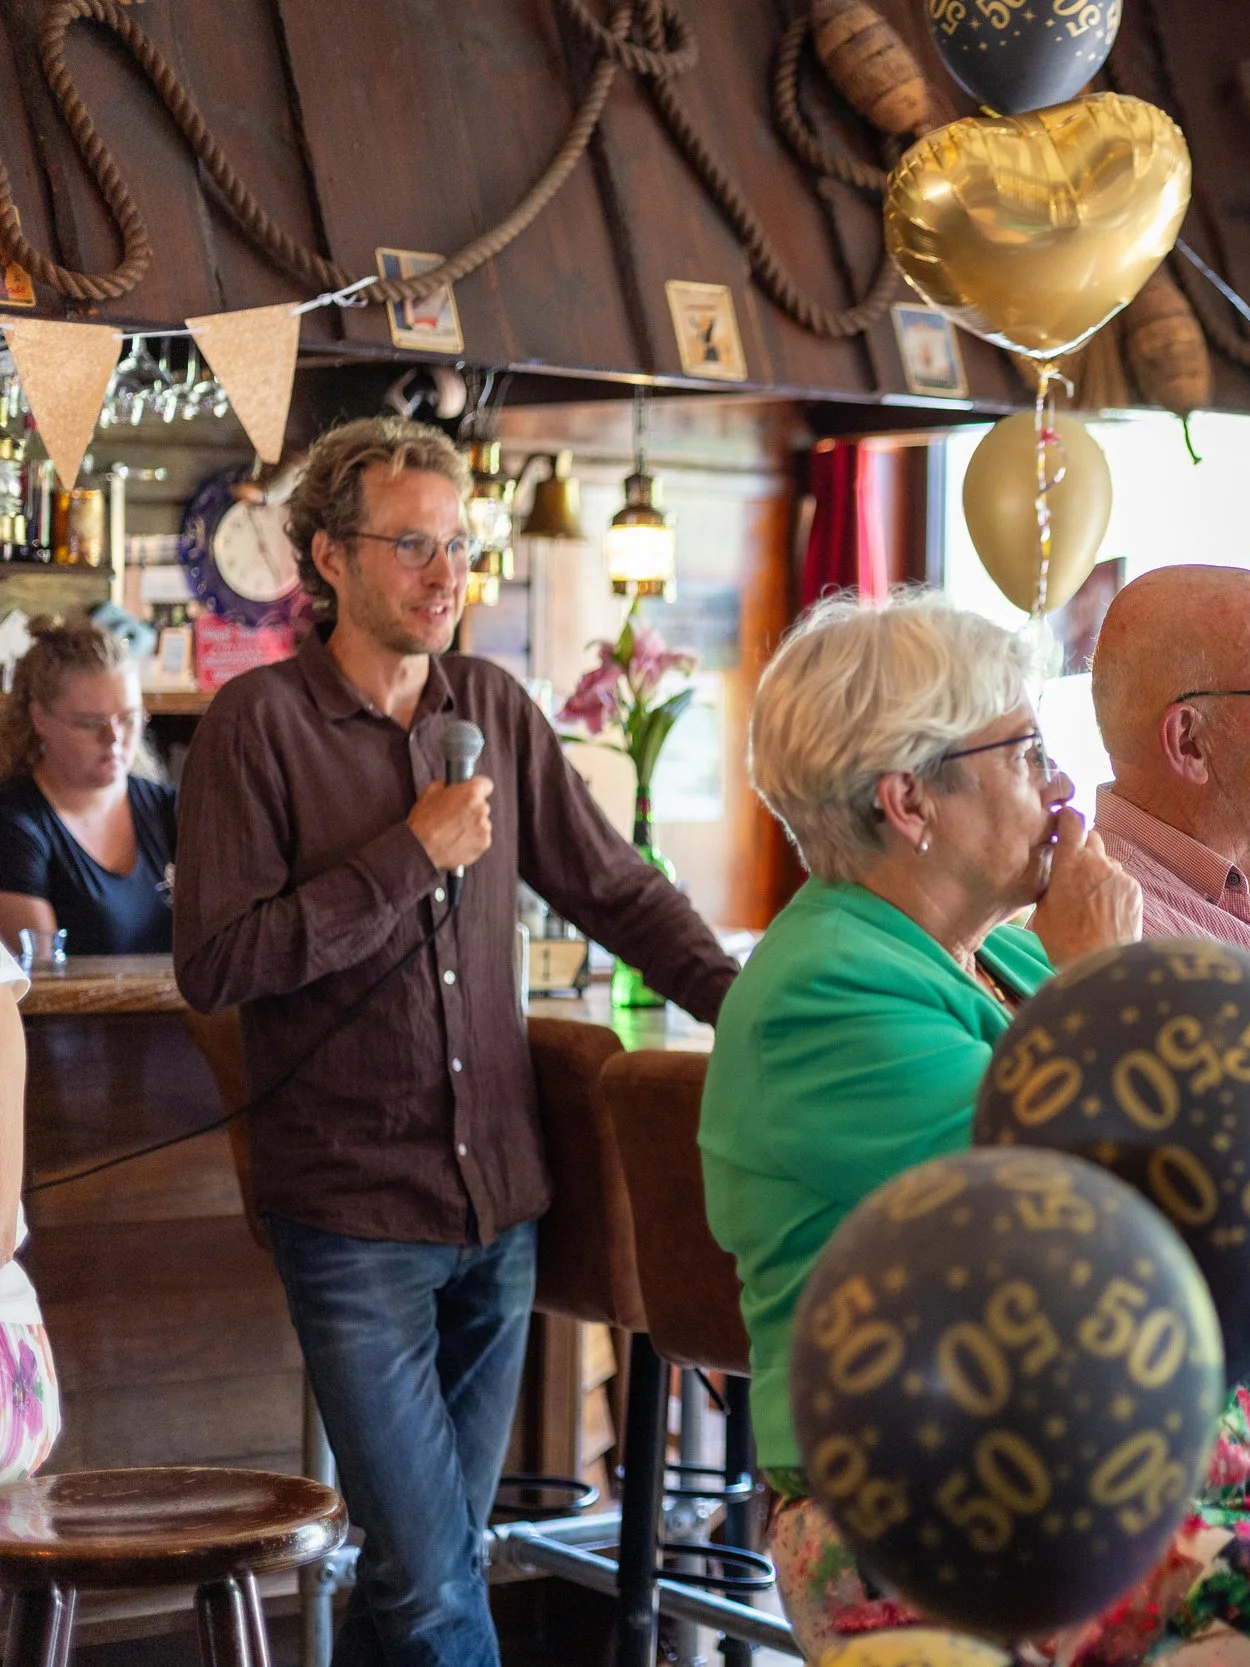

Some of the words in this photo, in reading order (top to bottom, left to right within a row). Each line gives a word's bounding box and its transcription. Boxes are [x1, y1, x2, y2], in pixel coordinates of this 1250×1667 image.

[975, 0, 1028, 30] 5
[996, 1028, 1084, 1127] 50
[1112, 1014, 1224, 1132] 50
[1147, 1143, 1219, 1226] 0
[810, 1273, 906, 1396] 50
[935, 1281, 1063, 1416] 50
[1078, 1276, 1187, 1390] 50
[936, 1430, 1055, 1553] 50
[1089, 1429, 1188, 1536] 50
